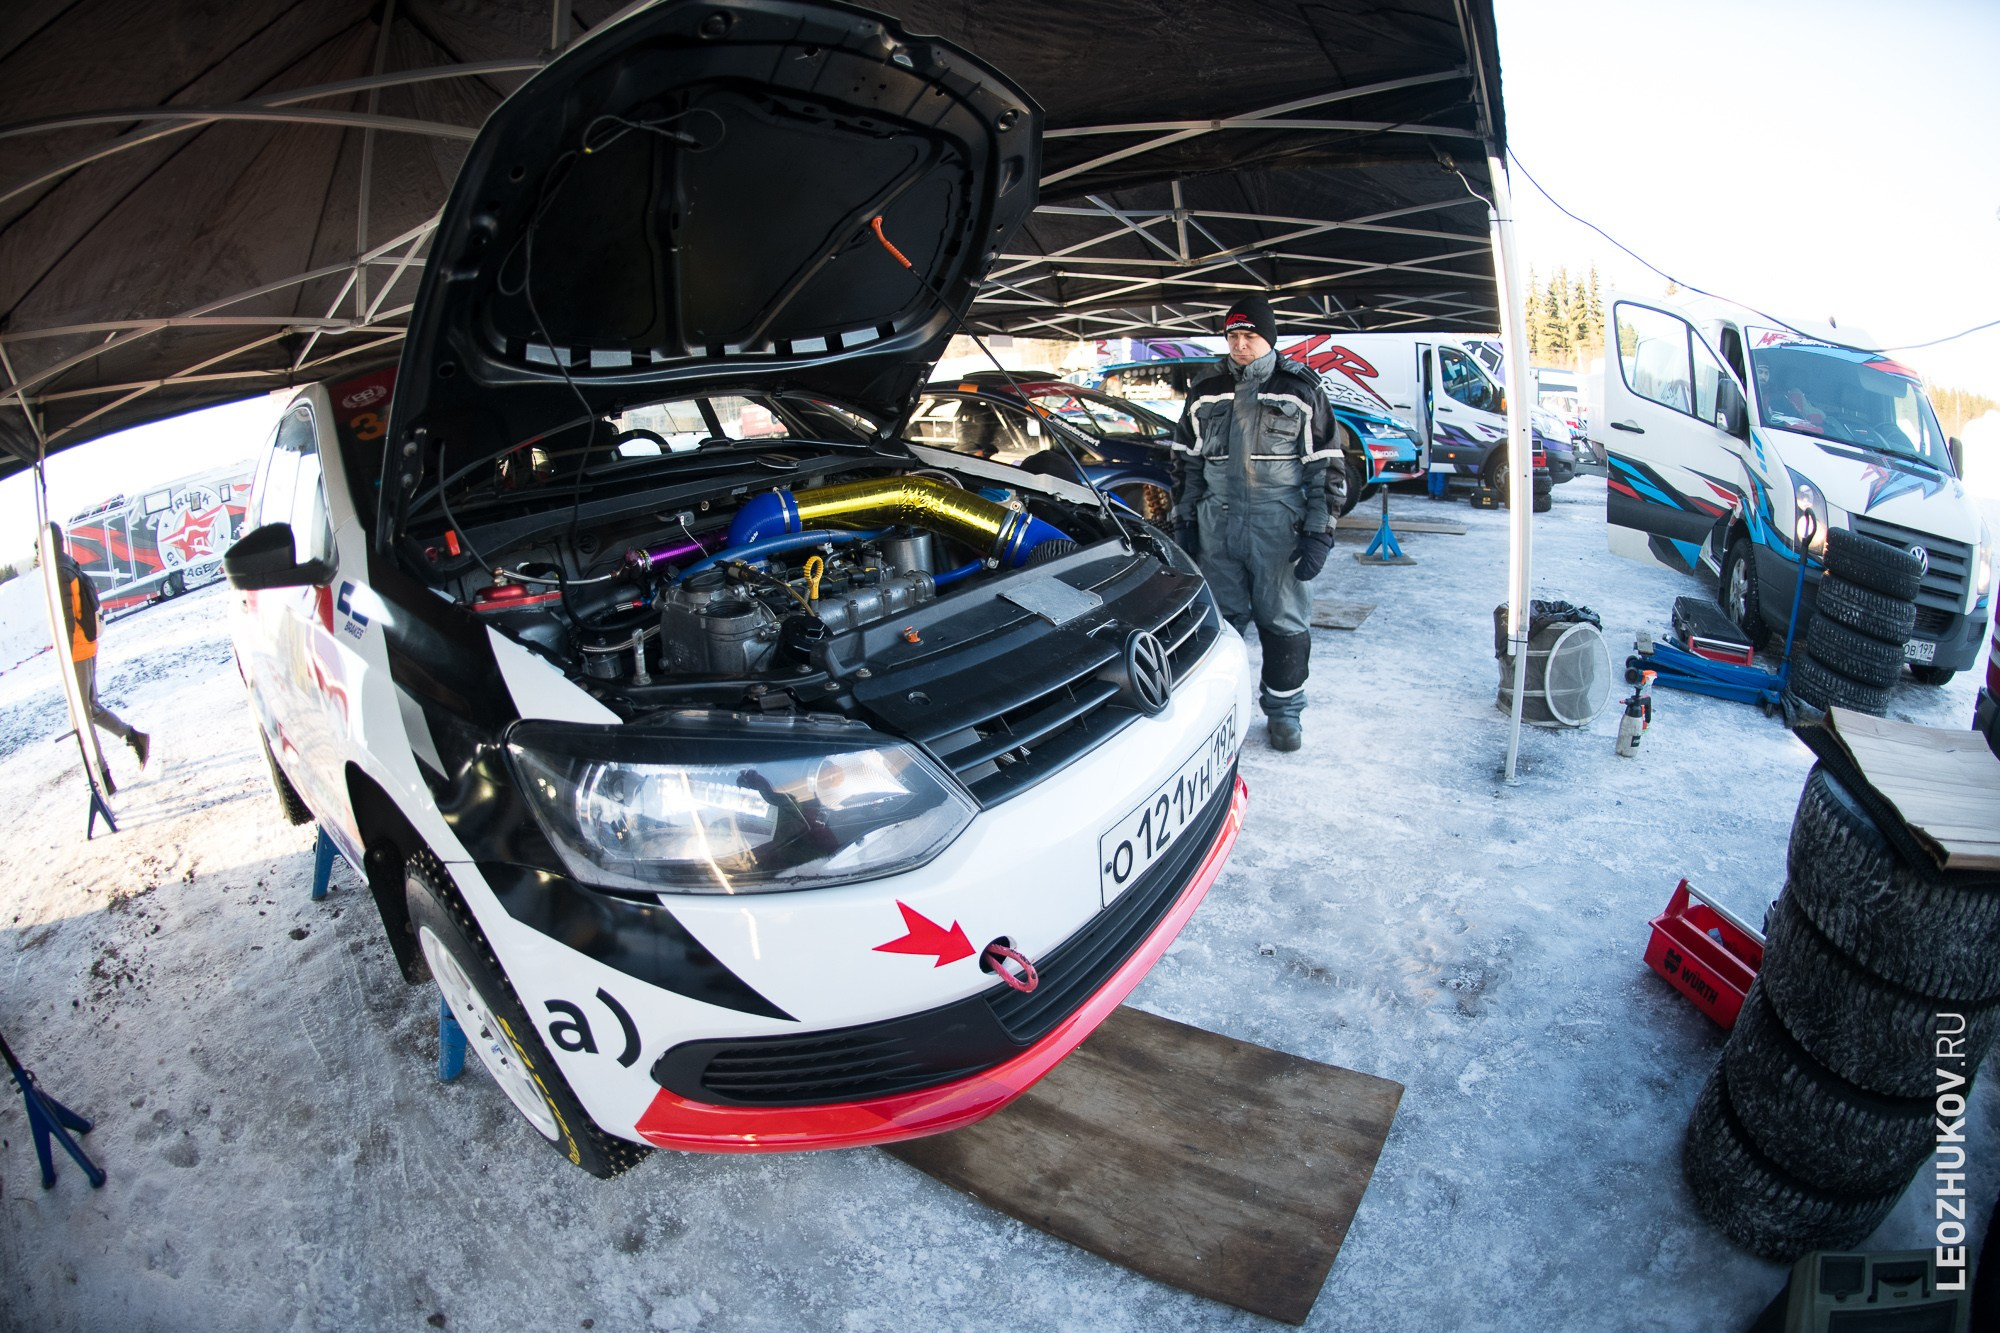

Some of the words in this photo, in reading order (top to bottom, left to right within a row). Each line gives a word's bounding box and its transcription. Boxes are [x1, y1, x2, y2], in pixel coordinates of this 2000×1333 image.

[1055, 418, 1100, 447] mrmotorsport
[344, 620, 364, 640] BRAKES
[1919, 642, 1934, 656] 197
[1213, 713, 1233, 766] 197
[1680, 965, 1719, 1006] WÜRTH
